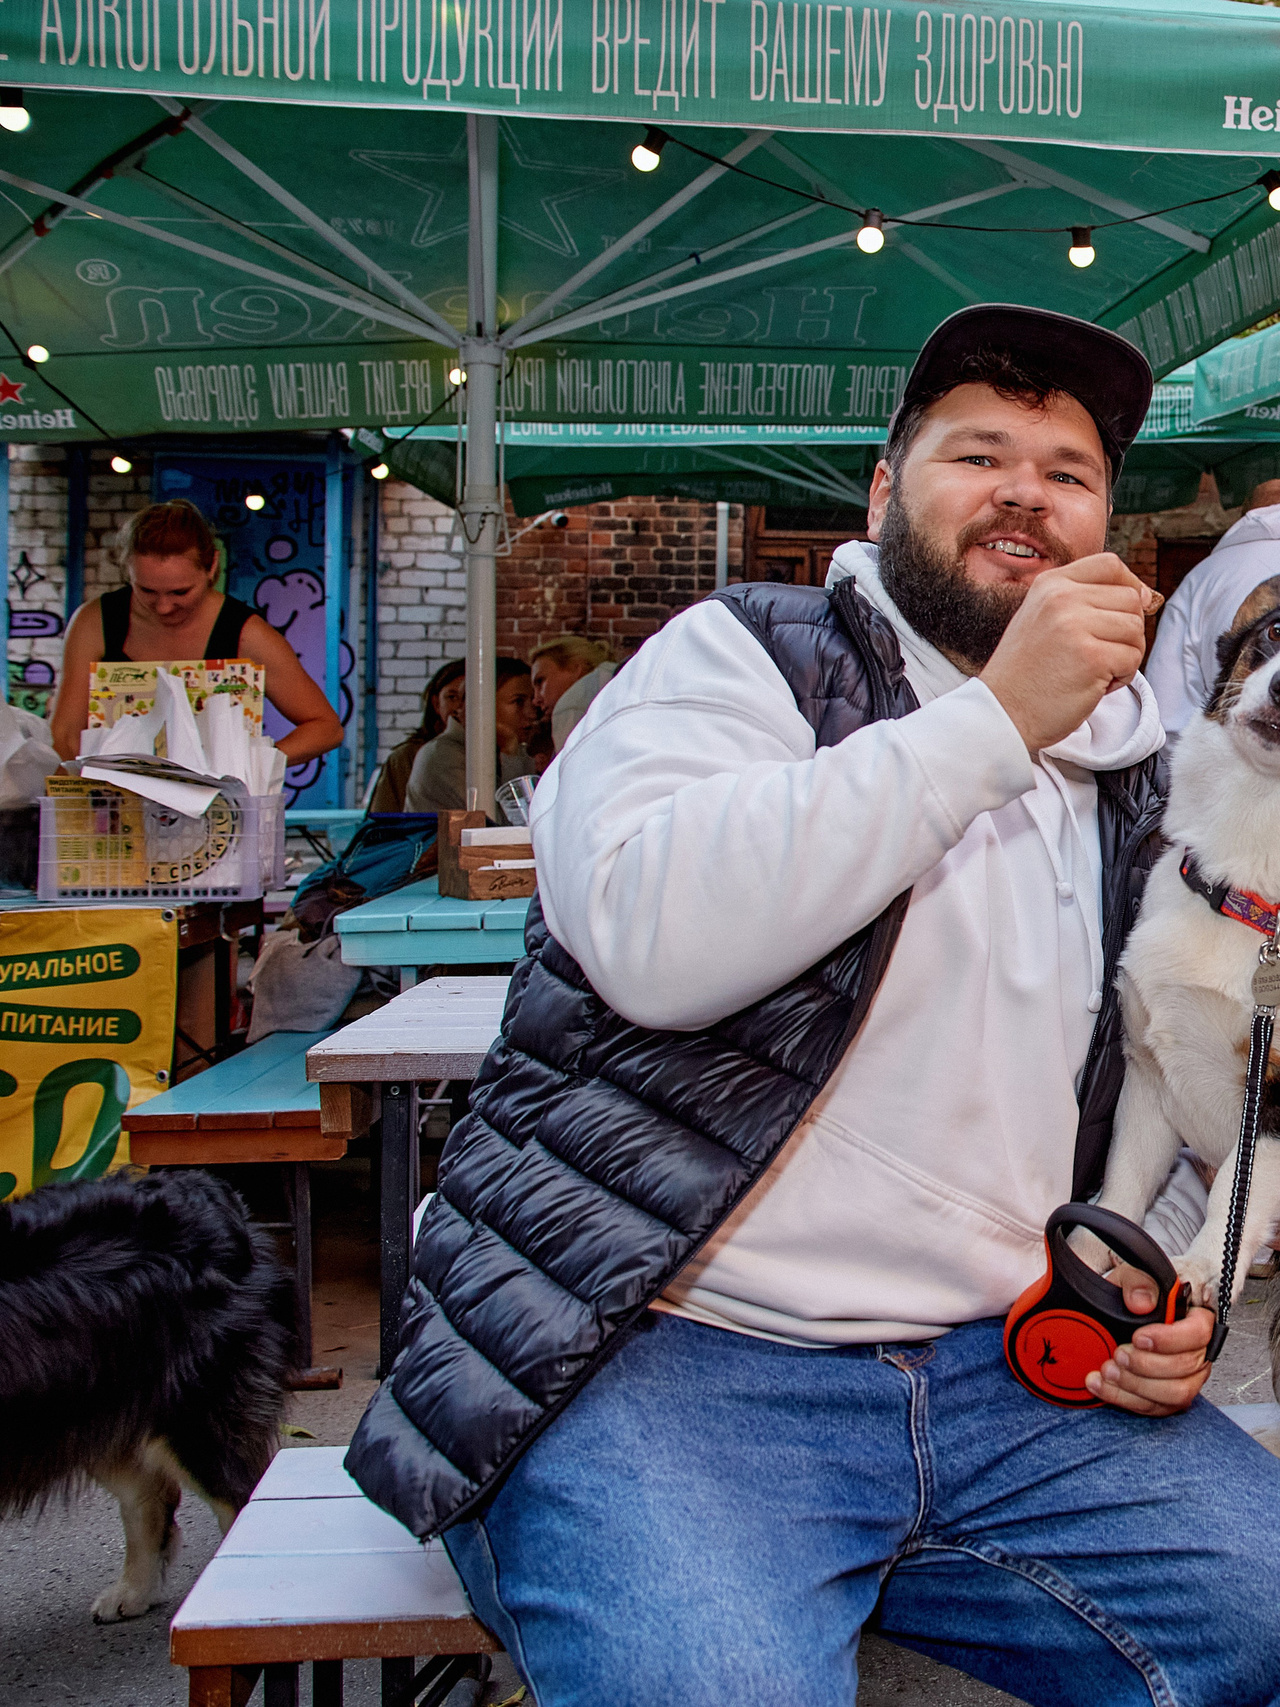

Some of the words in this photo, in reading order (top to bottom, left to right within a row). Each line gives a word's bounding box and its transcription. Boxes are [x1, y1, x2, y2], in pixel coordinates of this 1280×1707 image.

[357, 0, 563, 105] ПРОДУКЦИИ
[592, 0, 726, 112] ВРЕДИТ
[751, 0, 892, 108] ВАШЕМУ
[915, 10, 1084, 125] ЗДОРОВЬЮ
[2, 1011, 119, 1037] ПИТАНИЕ
